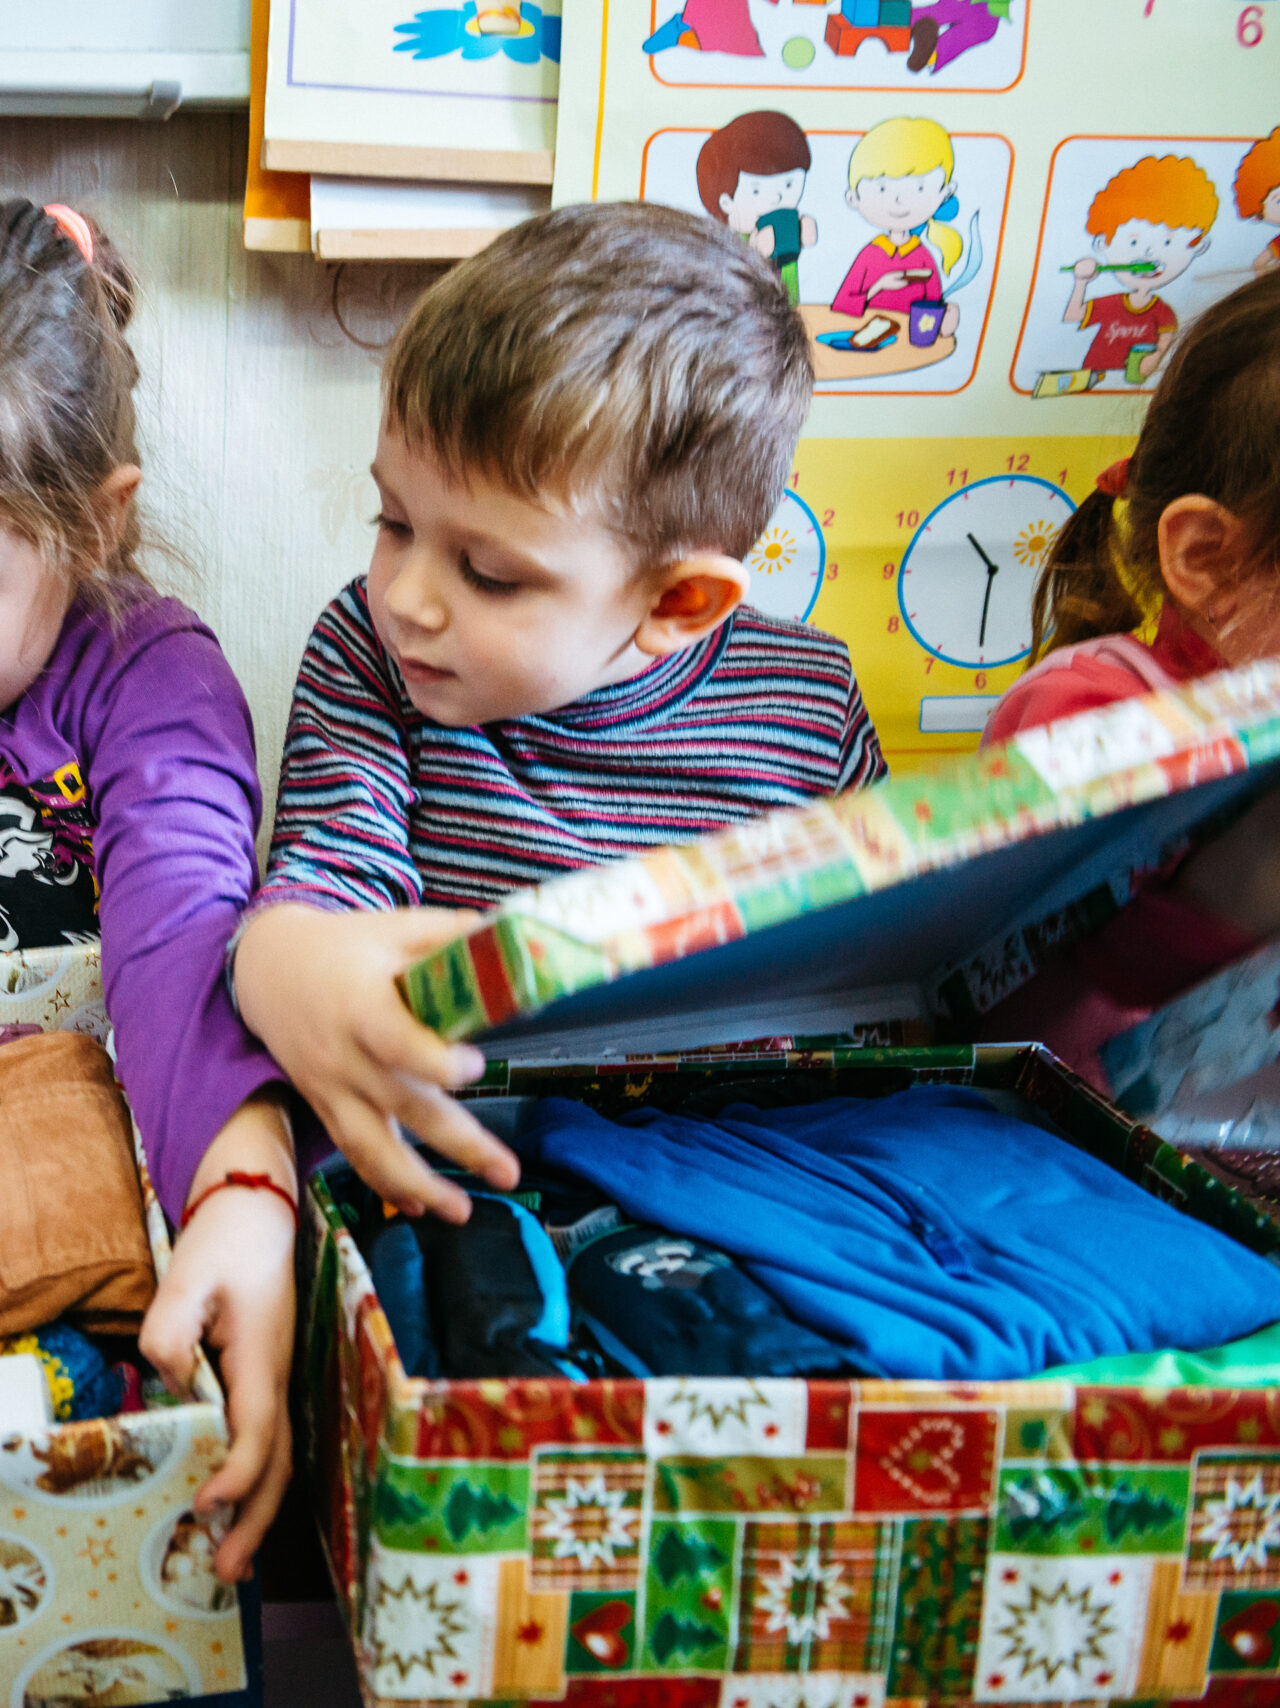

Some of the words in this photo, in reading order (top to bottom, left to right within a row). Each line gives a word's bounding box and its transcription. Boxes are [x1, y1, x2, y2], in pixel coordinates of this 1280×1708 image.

[1236, 5, 1264, 49] 6
[1105, 321, 1149, 345] Sport
[1006, 453, 1031, 472] 12
[791, 471, 800, 489] 1
[946, 468, 969, 486] 11
[1059, 468, 1068, 486] 1
[822, 509, 836, 527] 2
[895, 510, 920, 528] 10
[826, 563, 839, 581] 3
[882, 562, 896, 580] 9
[887, 615, 900, 634] 8
[924, 657, 935, 675] 7
[974, 672, 987, 690] 6
